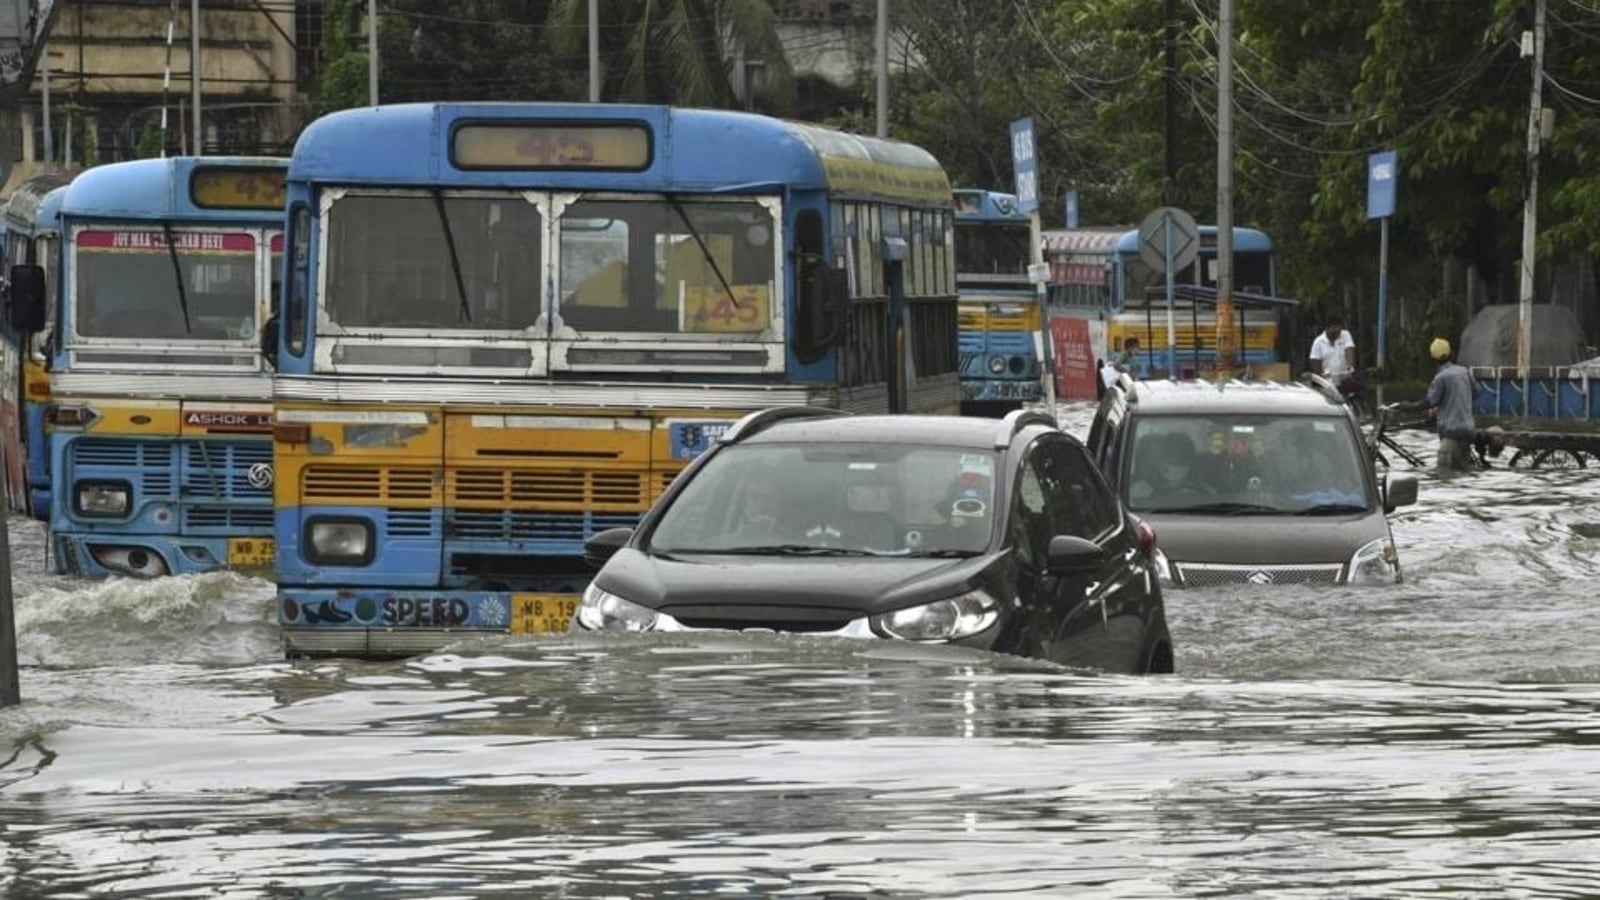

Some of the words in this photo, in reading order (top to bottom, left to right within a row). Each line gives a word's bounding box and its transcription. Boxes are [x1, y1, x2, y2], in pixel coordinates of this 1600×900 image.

[113, 232, 129, 247] JOY
[711, 295, 760, 326] 45
[188, 413, 248, 425] ASHOK
[382, 597, 470, 626] SPEED
